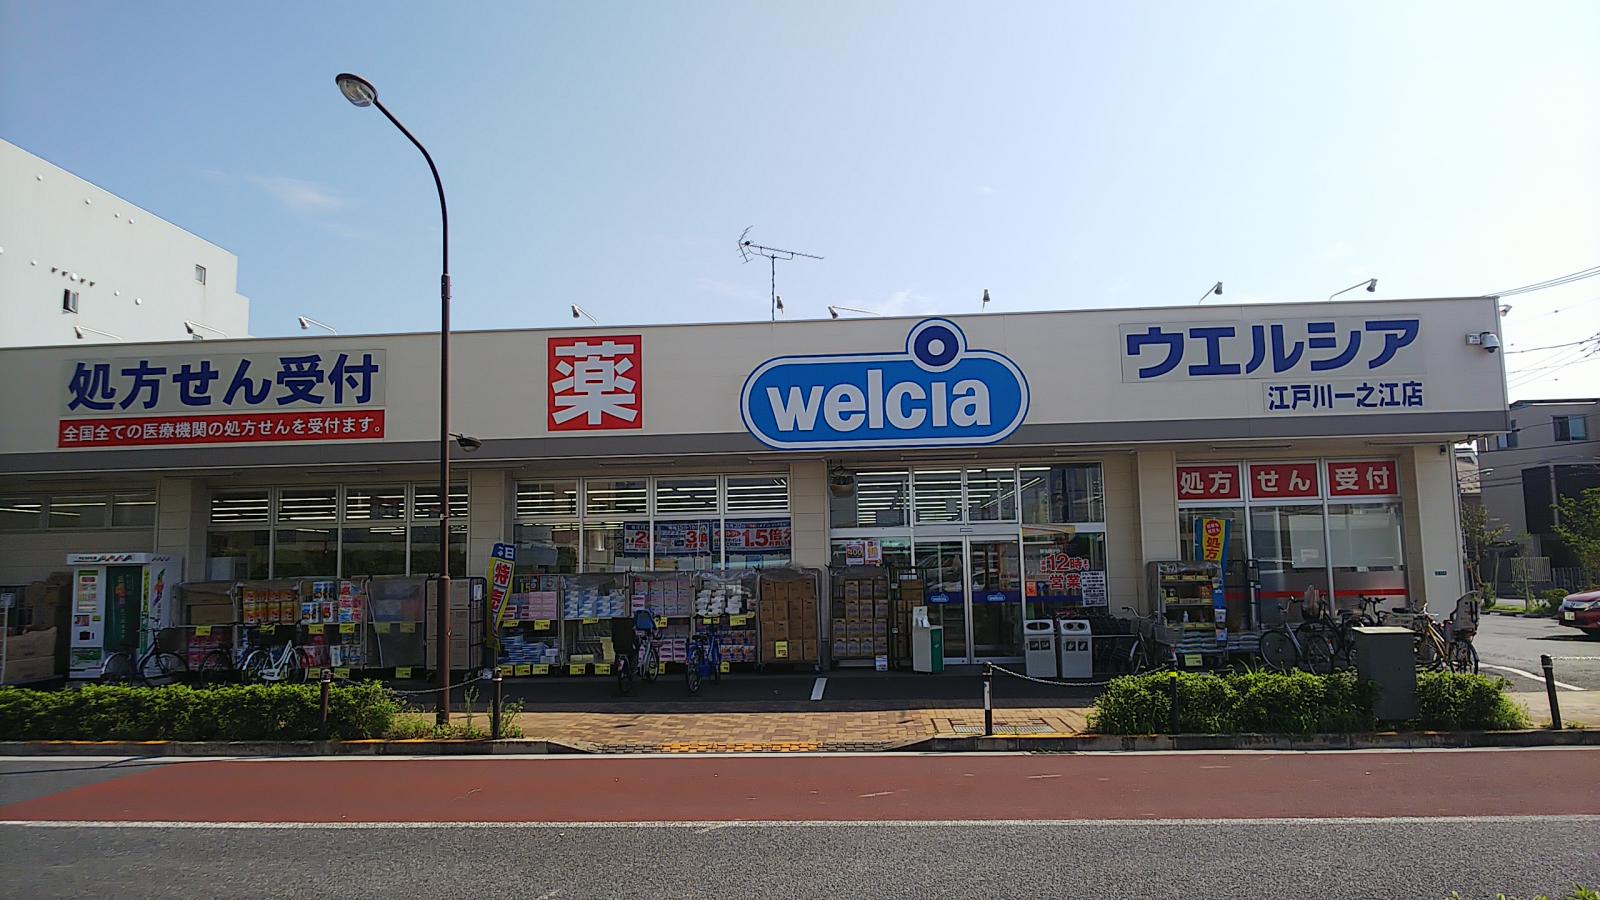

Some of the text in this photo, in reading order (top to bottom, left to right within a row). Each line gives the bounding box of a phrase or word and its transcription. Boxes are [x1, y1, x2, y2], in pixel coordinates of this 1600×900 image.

[1127, 319, 1420, 378] ウエルシア
[67, 353, 380, 411] 処方せん受付
[551, 341, 638, 425] 薬
[766, 369, 990, 431] welcia
[1268, 381, 1423, 411] 江戸川一之江店
[63, 417, 381, 443] 全国全ての医療機関の処方せんを受付ます。
[1179, 466, 1390, 495] 処方 せん 受付
[1049, 574, 1081, 591] 営業
